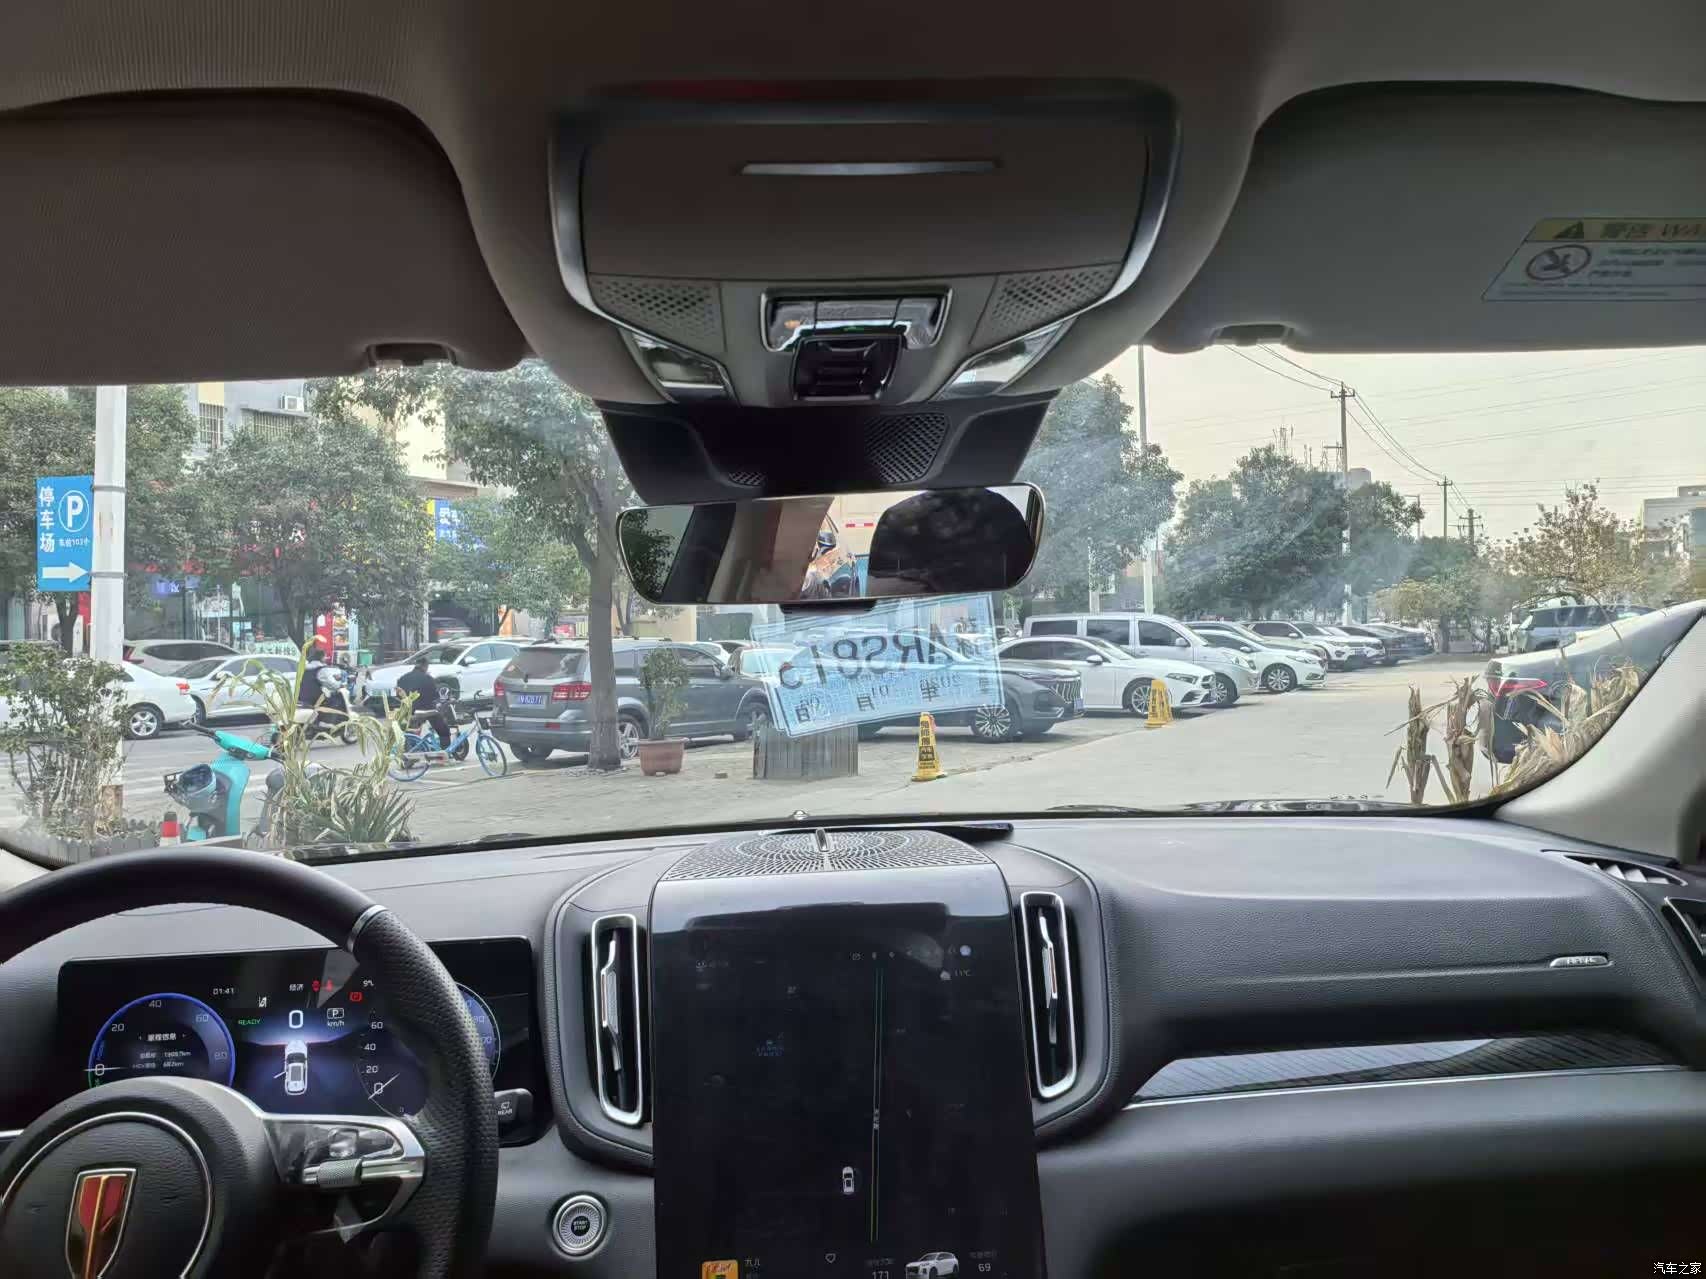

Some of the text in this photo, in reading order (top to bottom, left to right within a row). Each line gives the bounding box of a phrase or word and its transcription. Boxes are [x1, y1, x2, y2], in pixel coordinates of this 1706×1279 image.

[67, 495, 83, 528] P
[39, 486, 55, 552] 停车场
[149, 1000, 162, 1008] 40
[195, 1013, 209, 1023] 60
[238, 1018, 261, 1026] READY
[288, 1009, 304, 1029] 0
[111, 1023, 125, 1032] 20
[327, 1020, 345, 1028] km/h
[371, 1021, 384, 1030] 60
[363, 1043, 377, 1051] 40
[94, 1063, 105, 1077] 0
[366, 1065, 379, 1074] 20
[978, 1263, 992, 1272] 69
